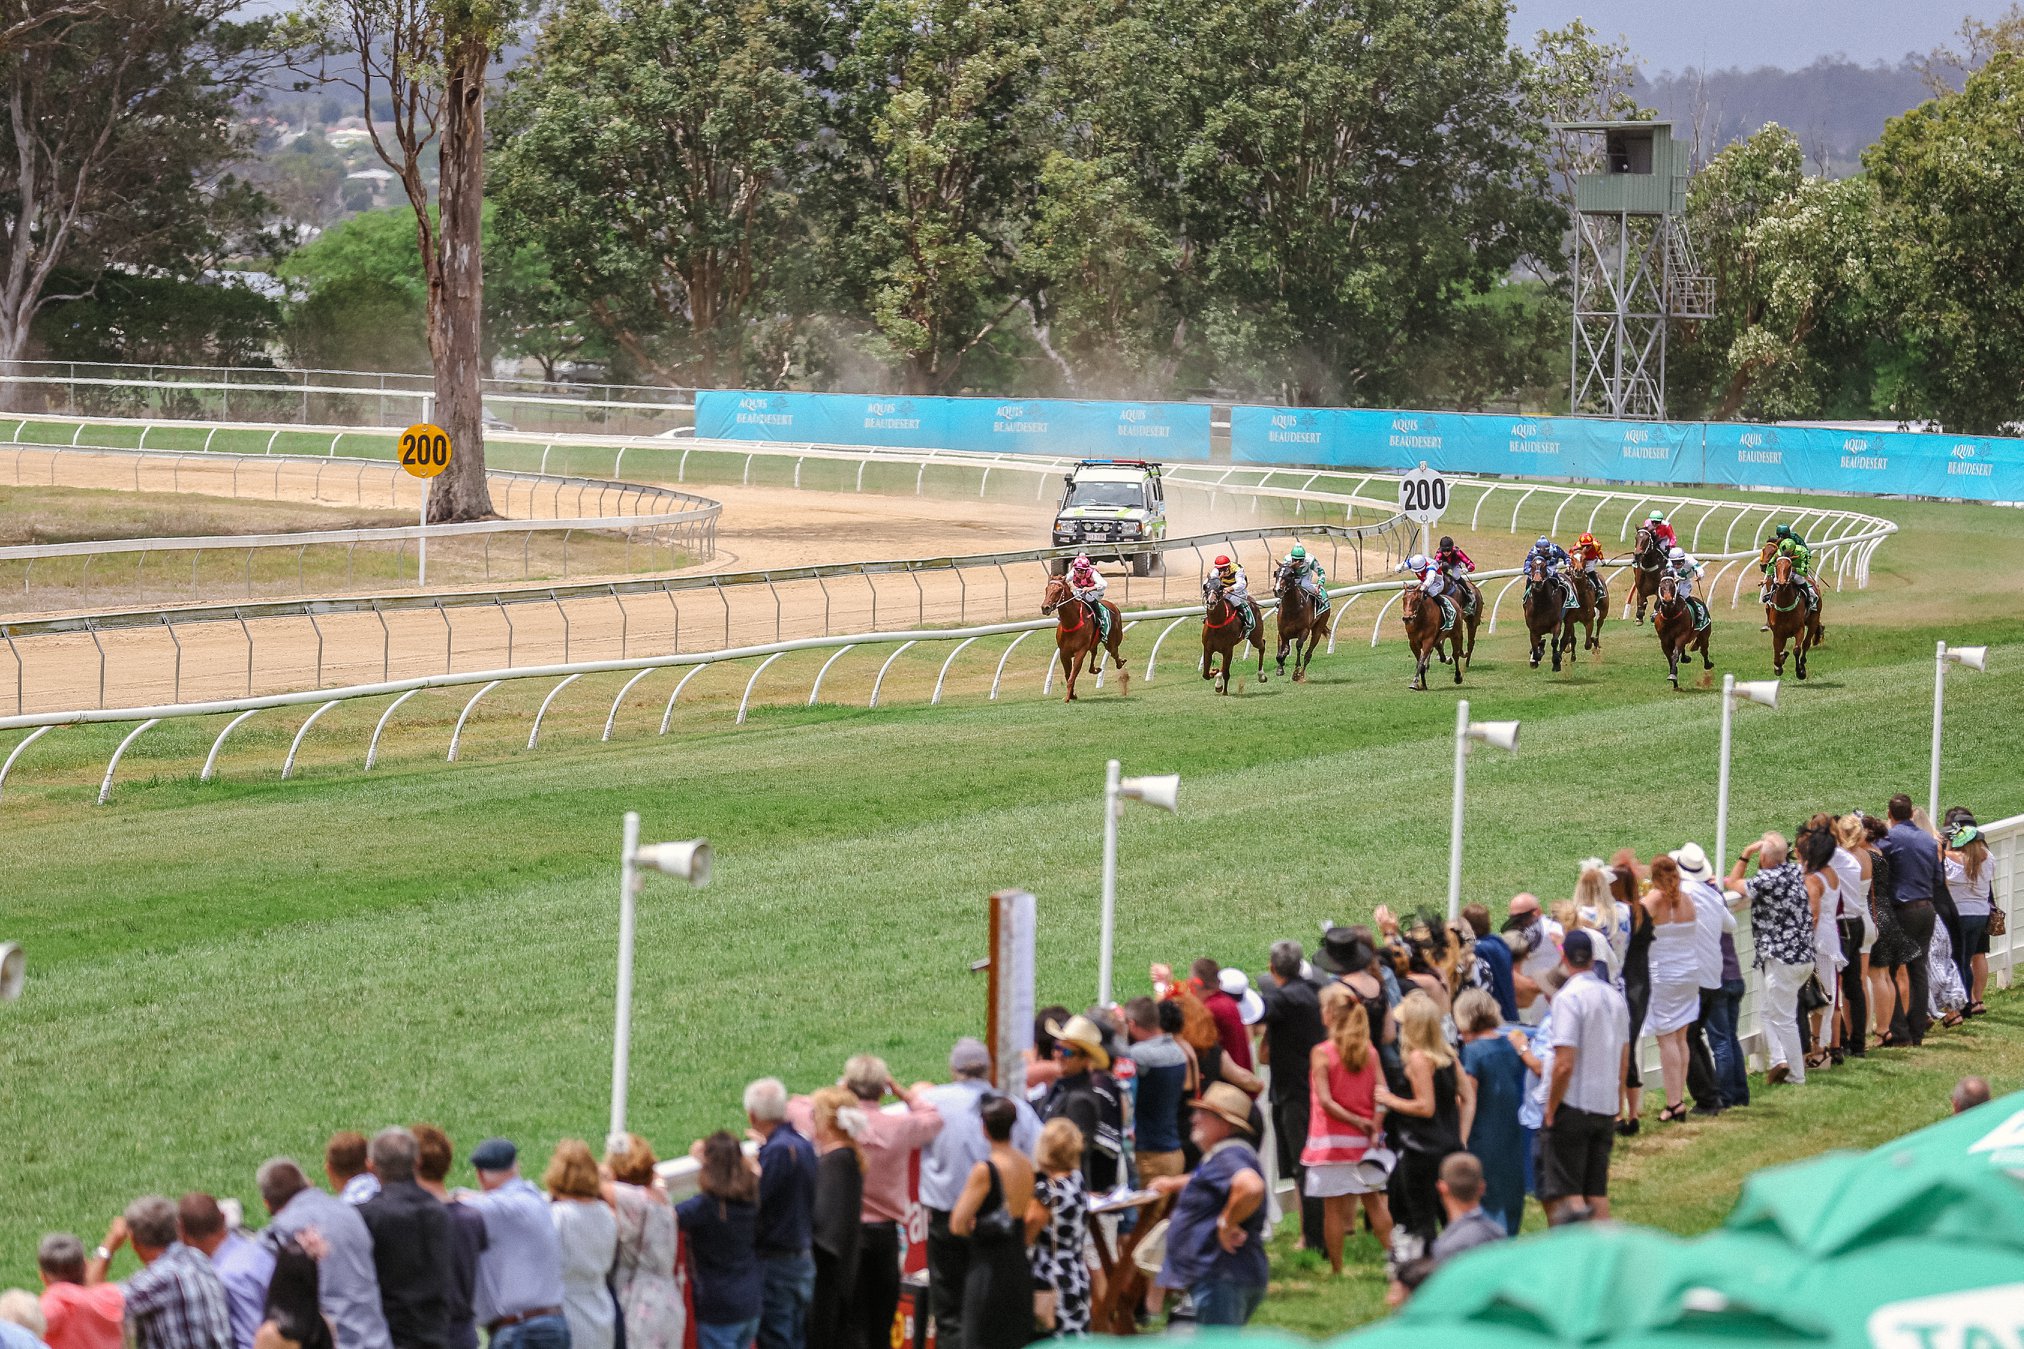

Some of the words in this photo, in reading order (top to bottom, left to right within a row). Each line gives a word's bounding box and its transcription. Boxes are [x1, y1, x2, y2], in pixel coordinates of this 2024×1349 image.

[739, 398, 768, 411] AQUIS
[867, 403, 896, 416] AQUIS
[996, 405, 1023, 419] AQUIS
[1120, 409, 1146, 422] AQUIS
[736, 413, 794, 425] BEAUDESERT
[864, 418, 920, 429] BEAUDESERT
[1271, 415, 1297, 430] AQUIS
[1392, 418, 1418, 433] AQUIS
[993, 421, 1048, 433] BEAUDESERT
[1118, 425, 1169, 437] BEAUDESERT
[1511, 424, 1537, 438] AQUIS
[1269, 431, 1322, 443] BEAUDESERT
[1390, 435, 1442, 448] BEAUDESERT
[1623, 430, 1649, 445] AQUIS
[1740, 433, 1763, 448] AQUIS
[403, 434, 446, 466] 200
[1509, 441, 1560, 454] BEAUDESERT
[1623, 446, 1669, 459] BEAUDESERT
[1843, 439, 1868, 454] AQUIS
[1951, 444, 1976, 459] AQUIS
[1738, 450, 1783, 464] BEAUDESERT
[1840, 456, 1888, 469] BEAUDESERT
[1947, 462, 1994, 476] BEAUDESERT
[1403, 478, 1446, 510] 200
